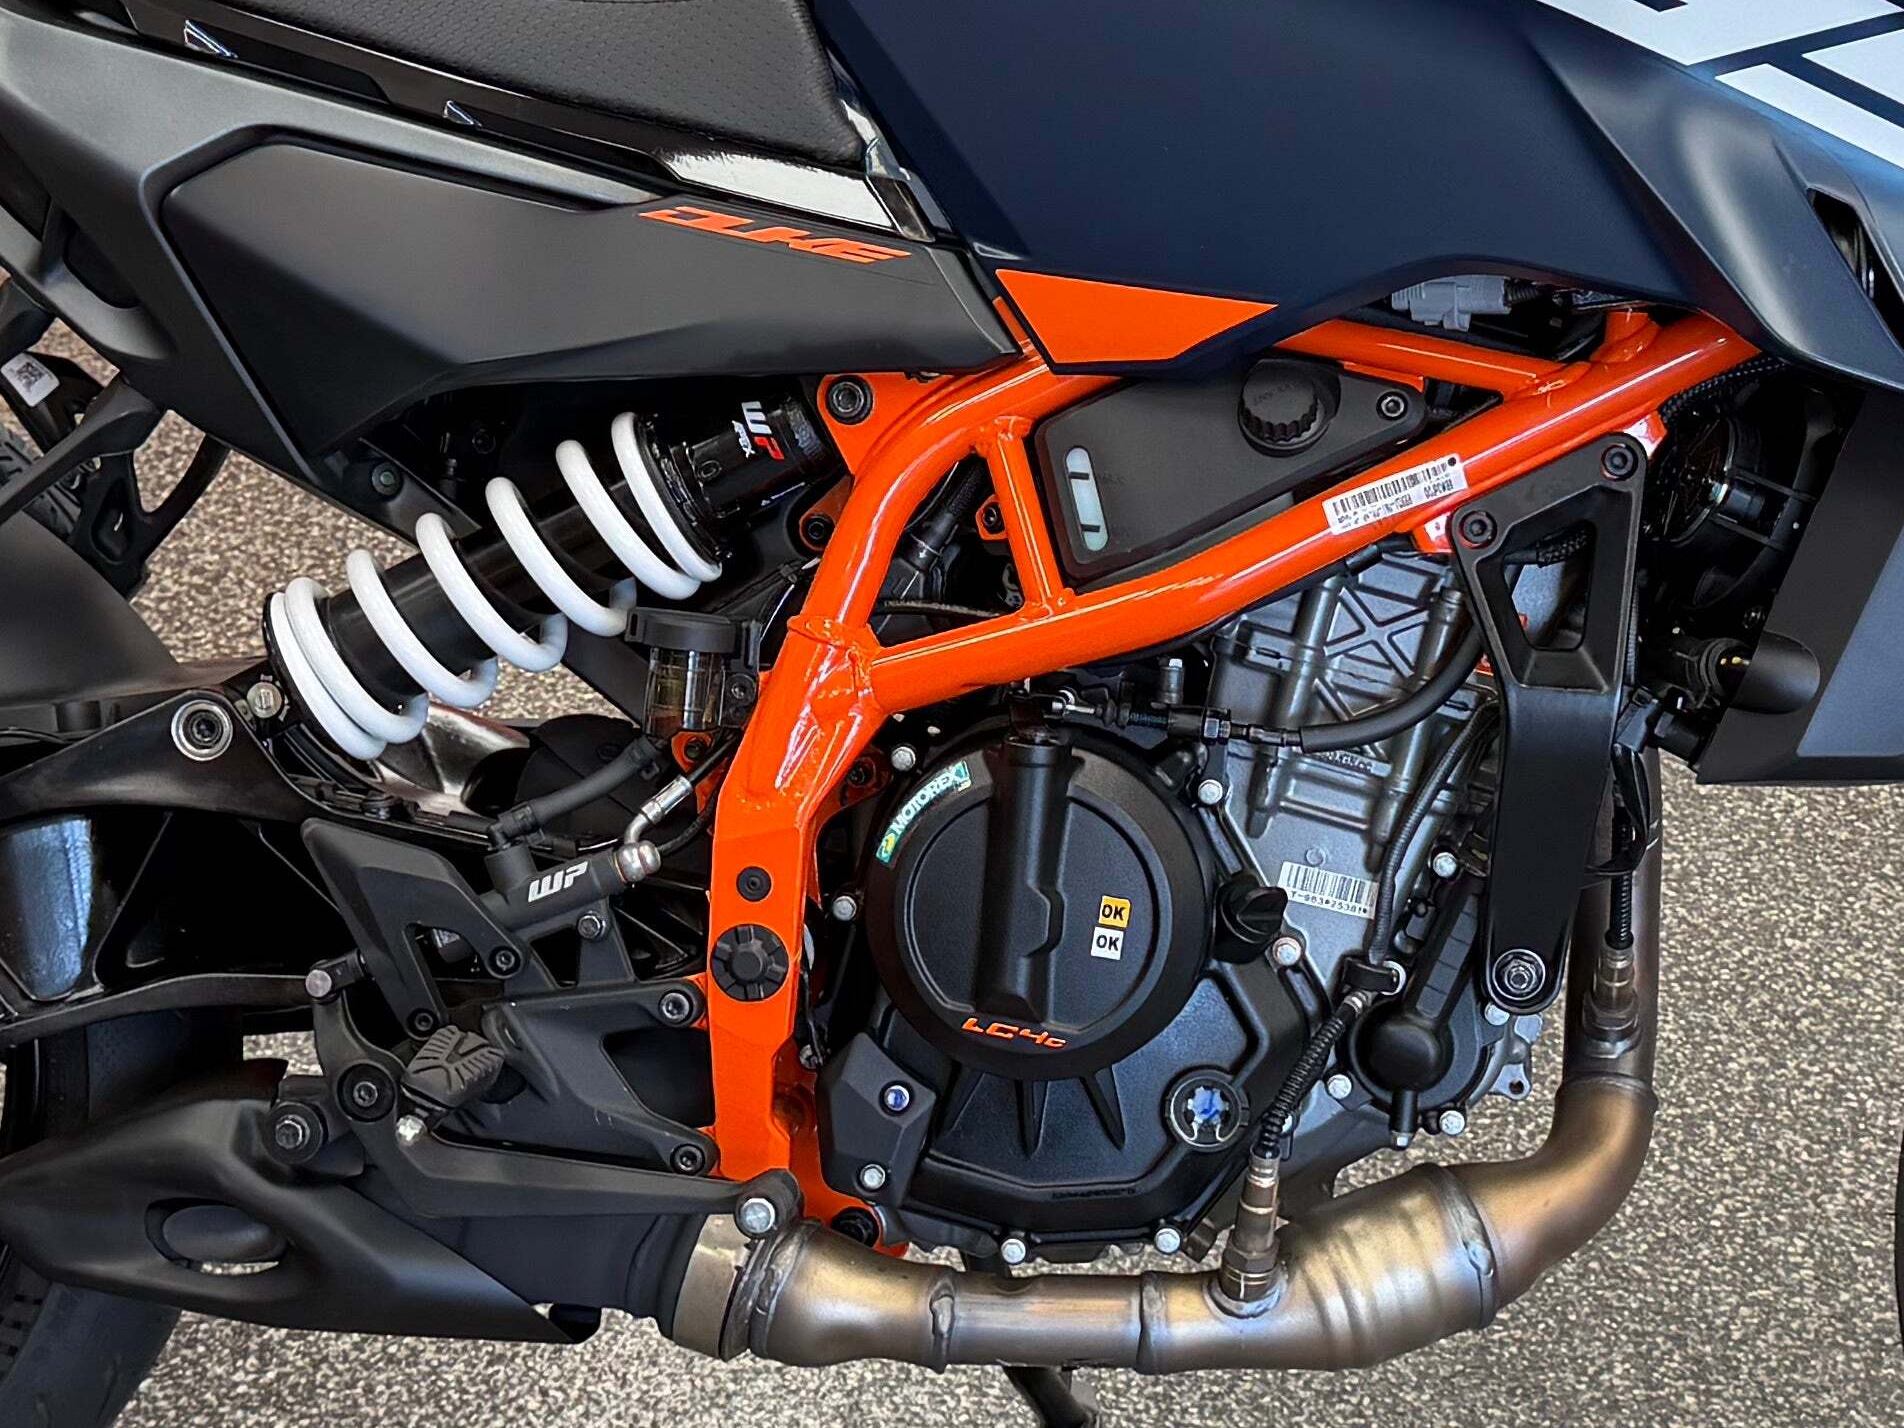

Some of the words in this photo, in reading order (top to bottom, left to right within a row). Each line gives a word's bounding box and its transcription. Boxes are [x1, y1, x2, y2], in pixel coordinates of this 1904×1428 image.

[638, 205, 913, 264] DUKE
[741, 401, 785, 460] WP
[891, 760, 968, 835] MOTOREX
[528, 860, 589, 903] WP
[1101, 903, 1127, 922] OK
[1096, 933, 1120, 952] OK
